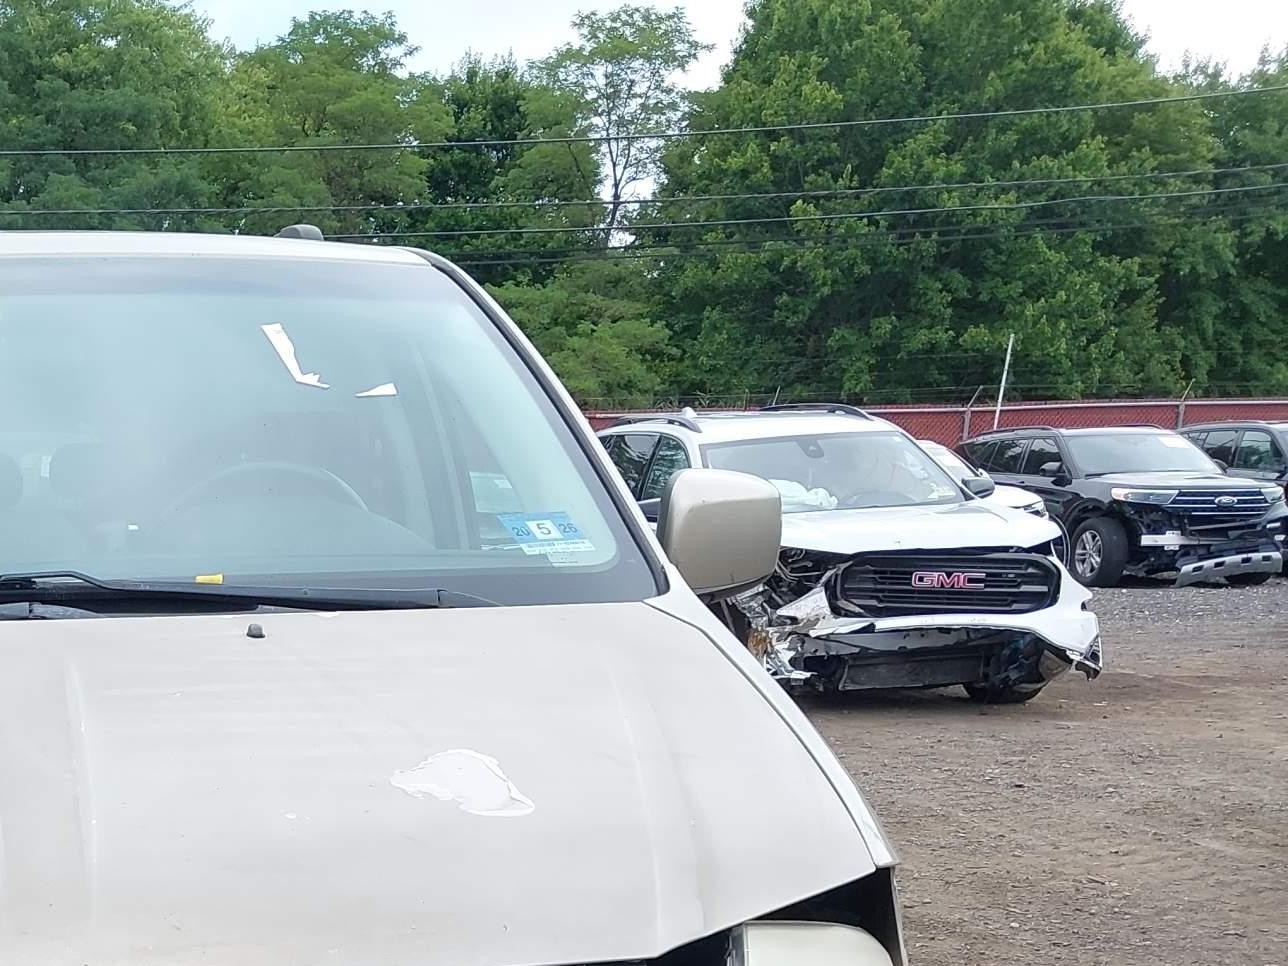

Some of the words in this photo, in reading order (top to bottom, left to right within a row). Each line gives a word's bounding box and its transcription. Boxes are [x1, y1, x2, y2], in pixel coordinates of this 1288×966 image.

[512, 526, 531, 536] 20
[536, 523, 552, 535] 5
[558, 523, 578, 534] 26
[912, 571, 986, 589] GMC
